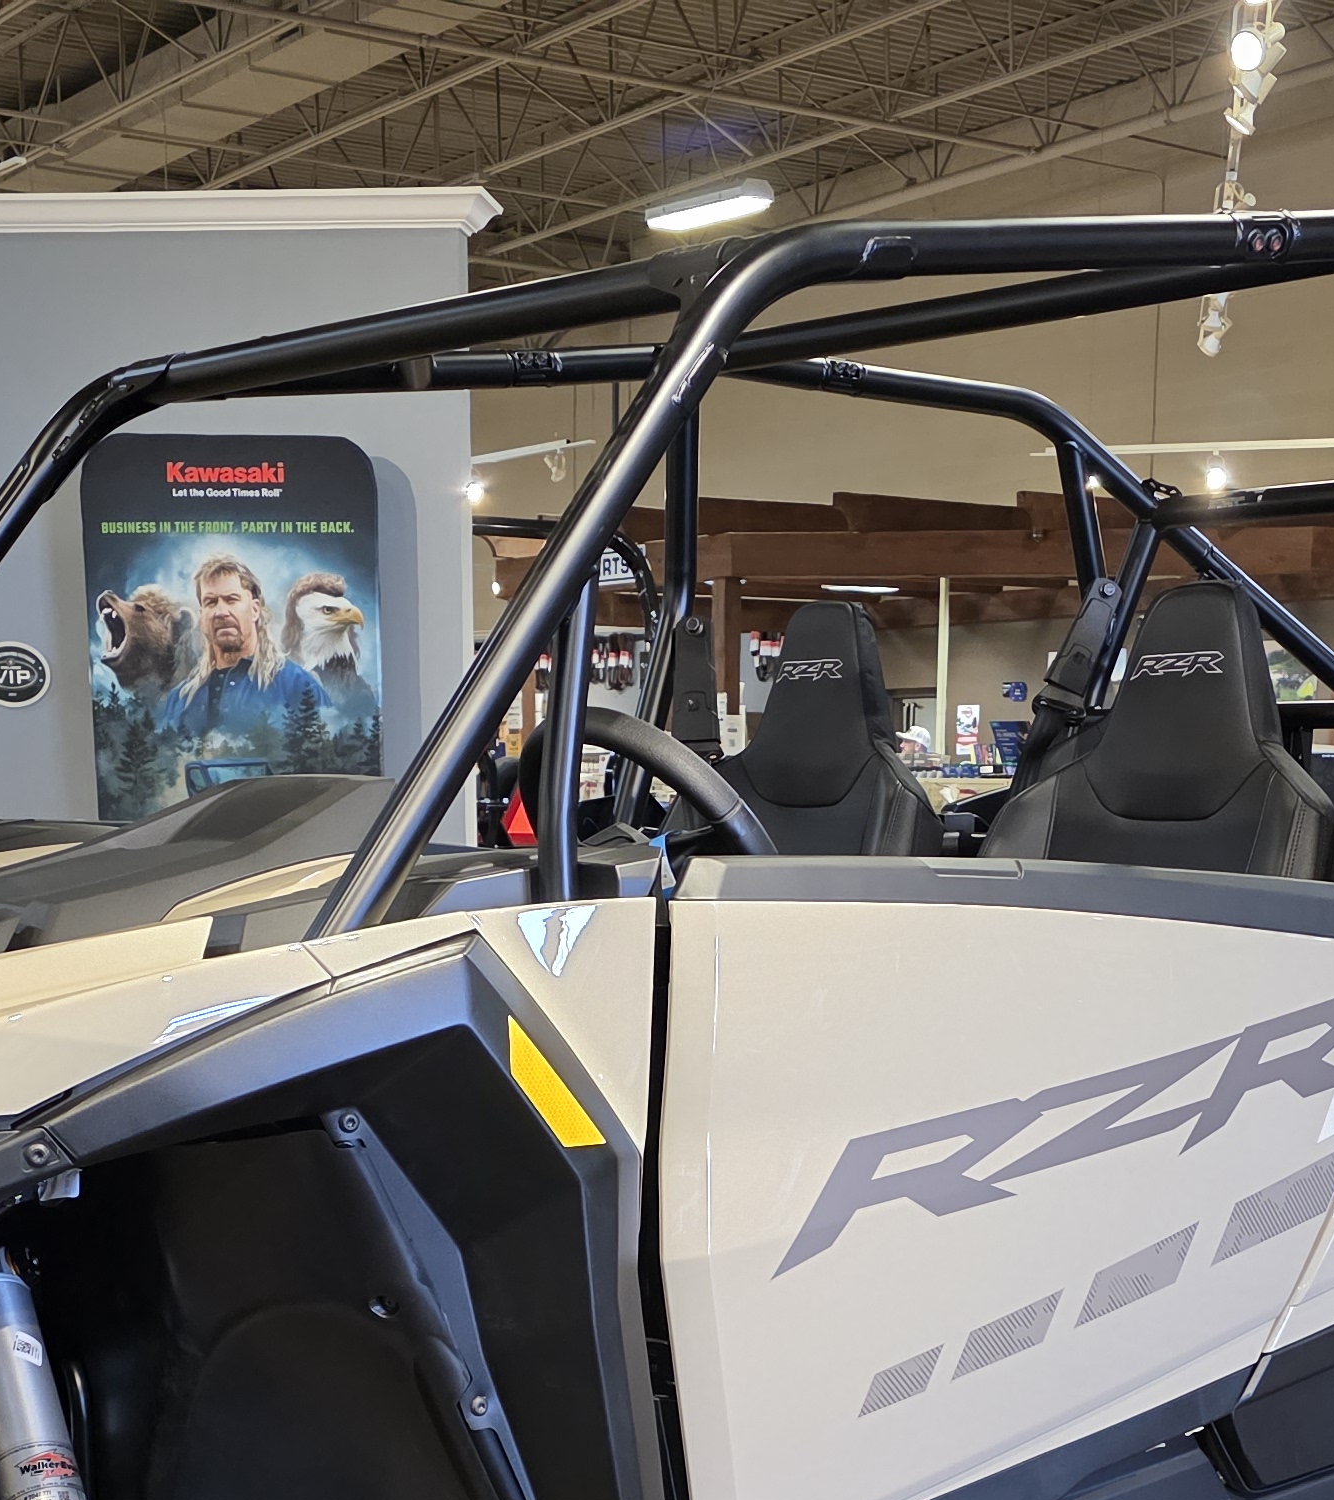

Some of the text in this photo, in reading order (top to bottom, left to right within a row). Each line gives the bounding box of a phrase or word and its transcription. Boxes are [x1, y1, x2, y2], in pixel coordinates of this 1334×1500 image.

[166, 461, 285, 483] Kawasaki
[172, 488, 187, 497] Let
[189, 488, 204, 497] the
[206, 488, 231, 497] Good
[232, 488, 260, 497] Times
[101, 521, 156, 534] BUSINESS
[159, 521, 171, 534] IN
[174, 521, 196, 534] THE
[241, 521, 277, 534] PARTY
[281, 521, 293, 534] IN
[296, 521, 318, 534] THE
[320, 521, 355, 534] BACK.
[603, 556, 629, 576] RTS
[776, 658, 843, 683] RZR
[1130, 651, 1224, 681] RZR
